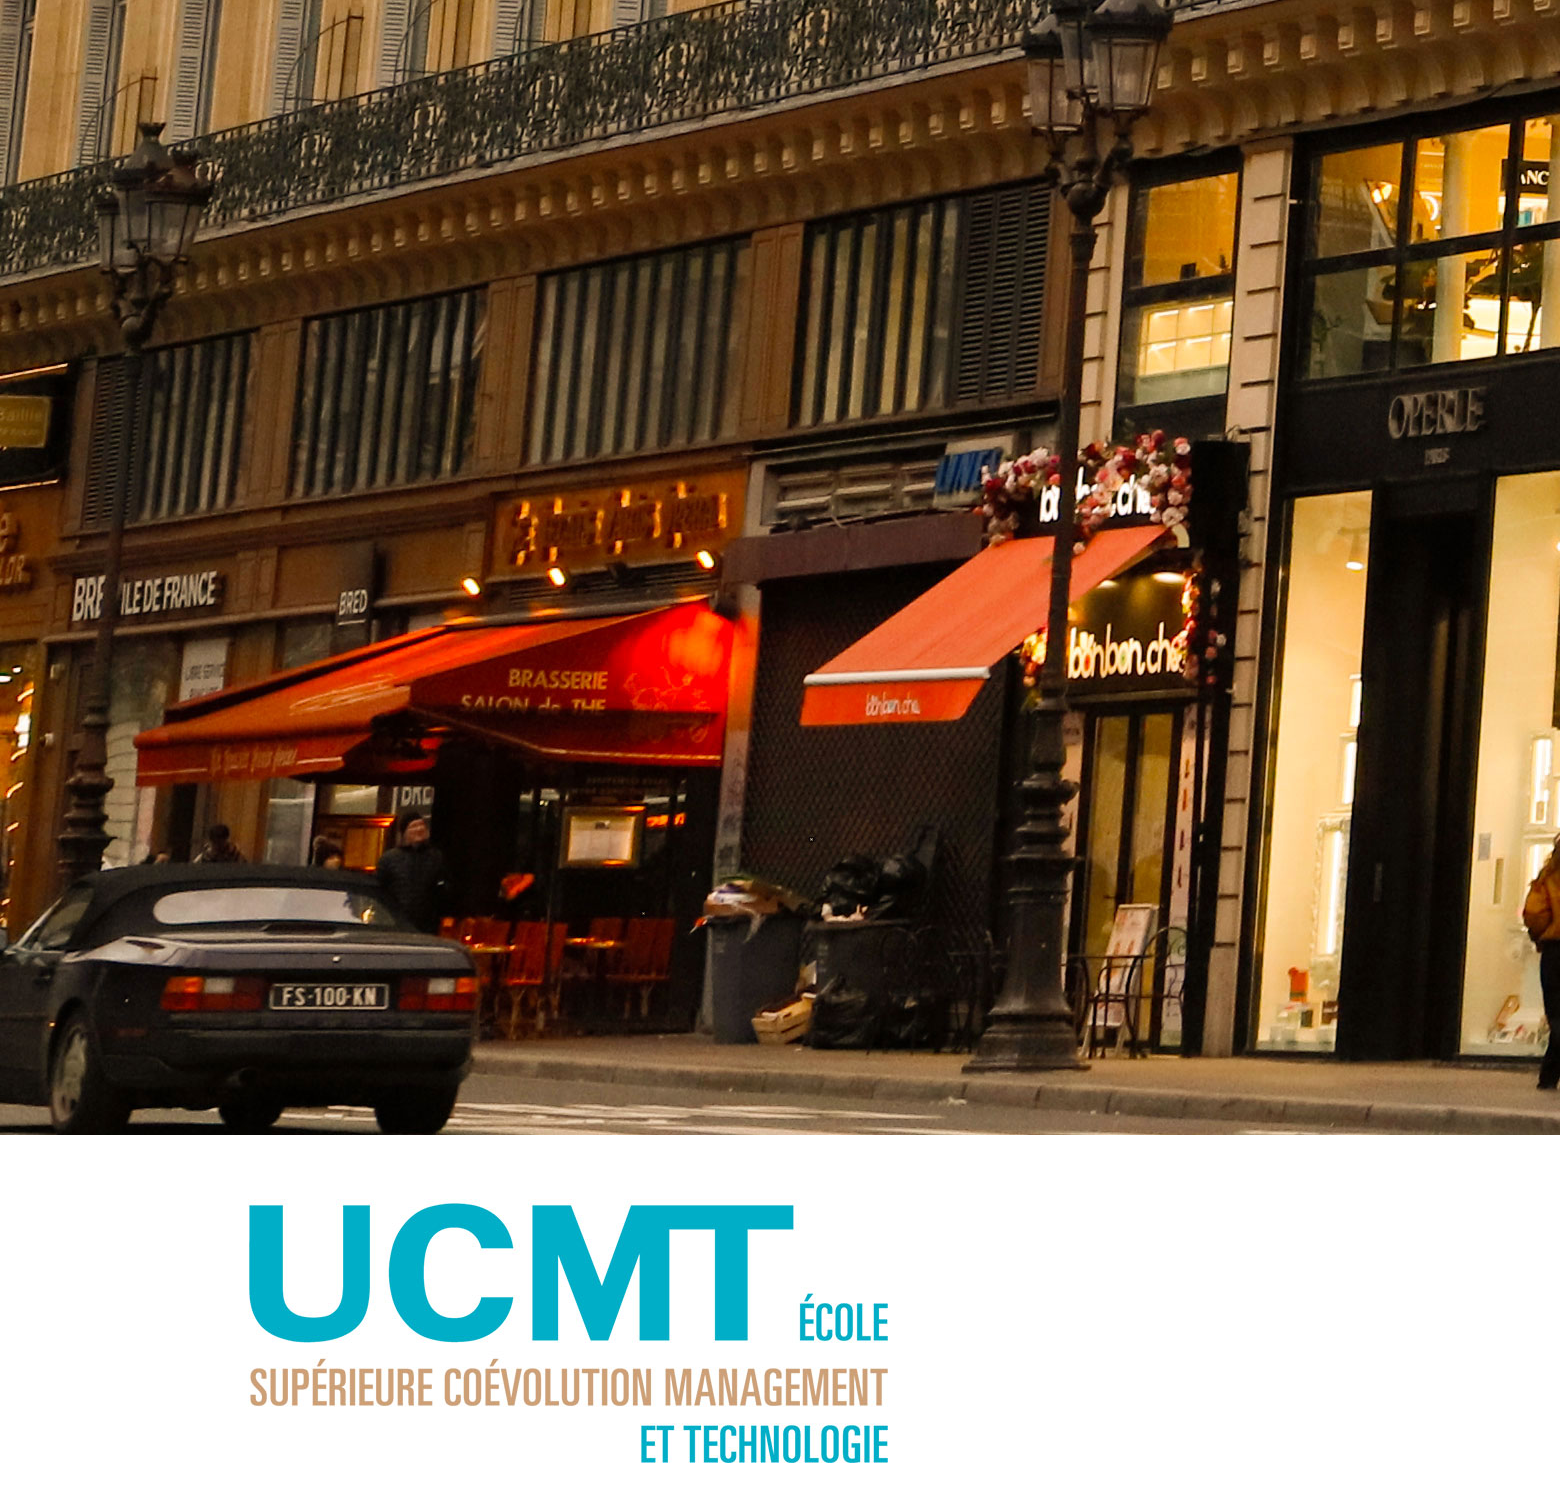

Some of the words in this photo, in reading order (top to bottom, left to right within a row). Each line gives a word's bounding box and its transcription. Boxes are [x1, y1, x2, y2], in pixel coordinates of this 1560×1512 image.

[72, 575, 106, 622] BRE
[120, 580, 143, 616] ILE
[142, 578, 162, 614] DE
[162, 570, 217, 611] FRANCE
[339, 589, 368, 616] BRED
[508, 668, 608, 690] BRASSERIE
[461, 695, 529, 712] SALON
[282, 987, 376, 1006] FS-100-KN
